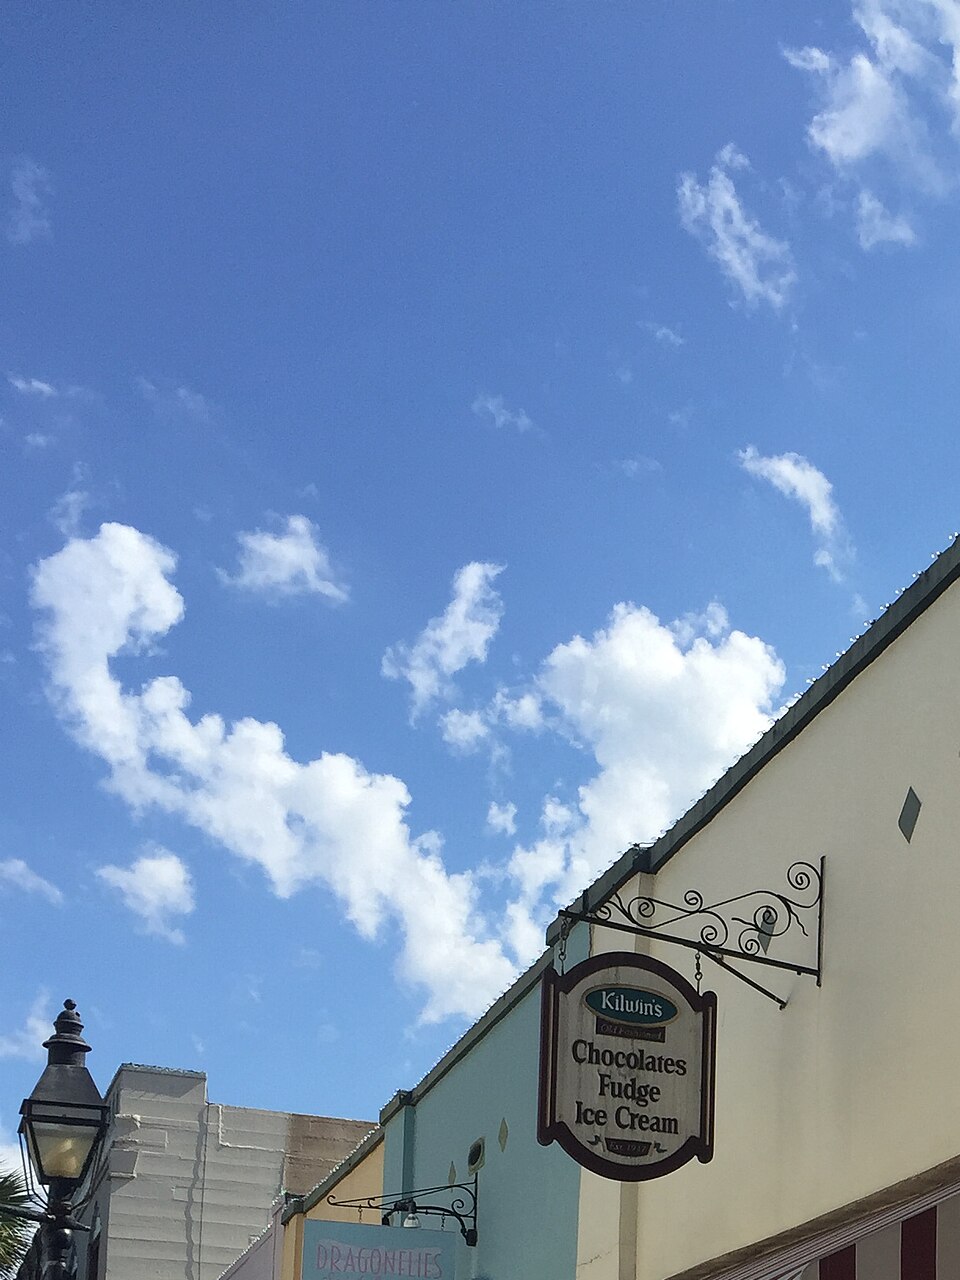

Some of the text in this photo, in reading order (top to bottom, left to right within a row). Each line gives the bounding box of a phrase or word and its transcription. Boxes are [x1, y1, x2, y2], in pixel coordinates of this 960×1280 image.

[601, 991, 663, 1018] Kilwin's
[572, 1039, 687, 1076] Chocolates
[598, 1073, 661, 1107] Fudge
[575, 1101, 679, 1135] Ice Cream
[316, 1243, 443, 1280] DRAGONFLIES
